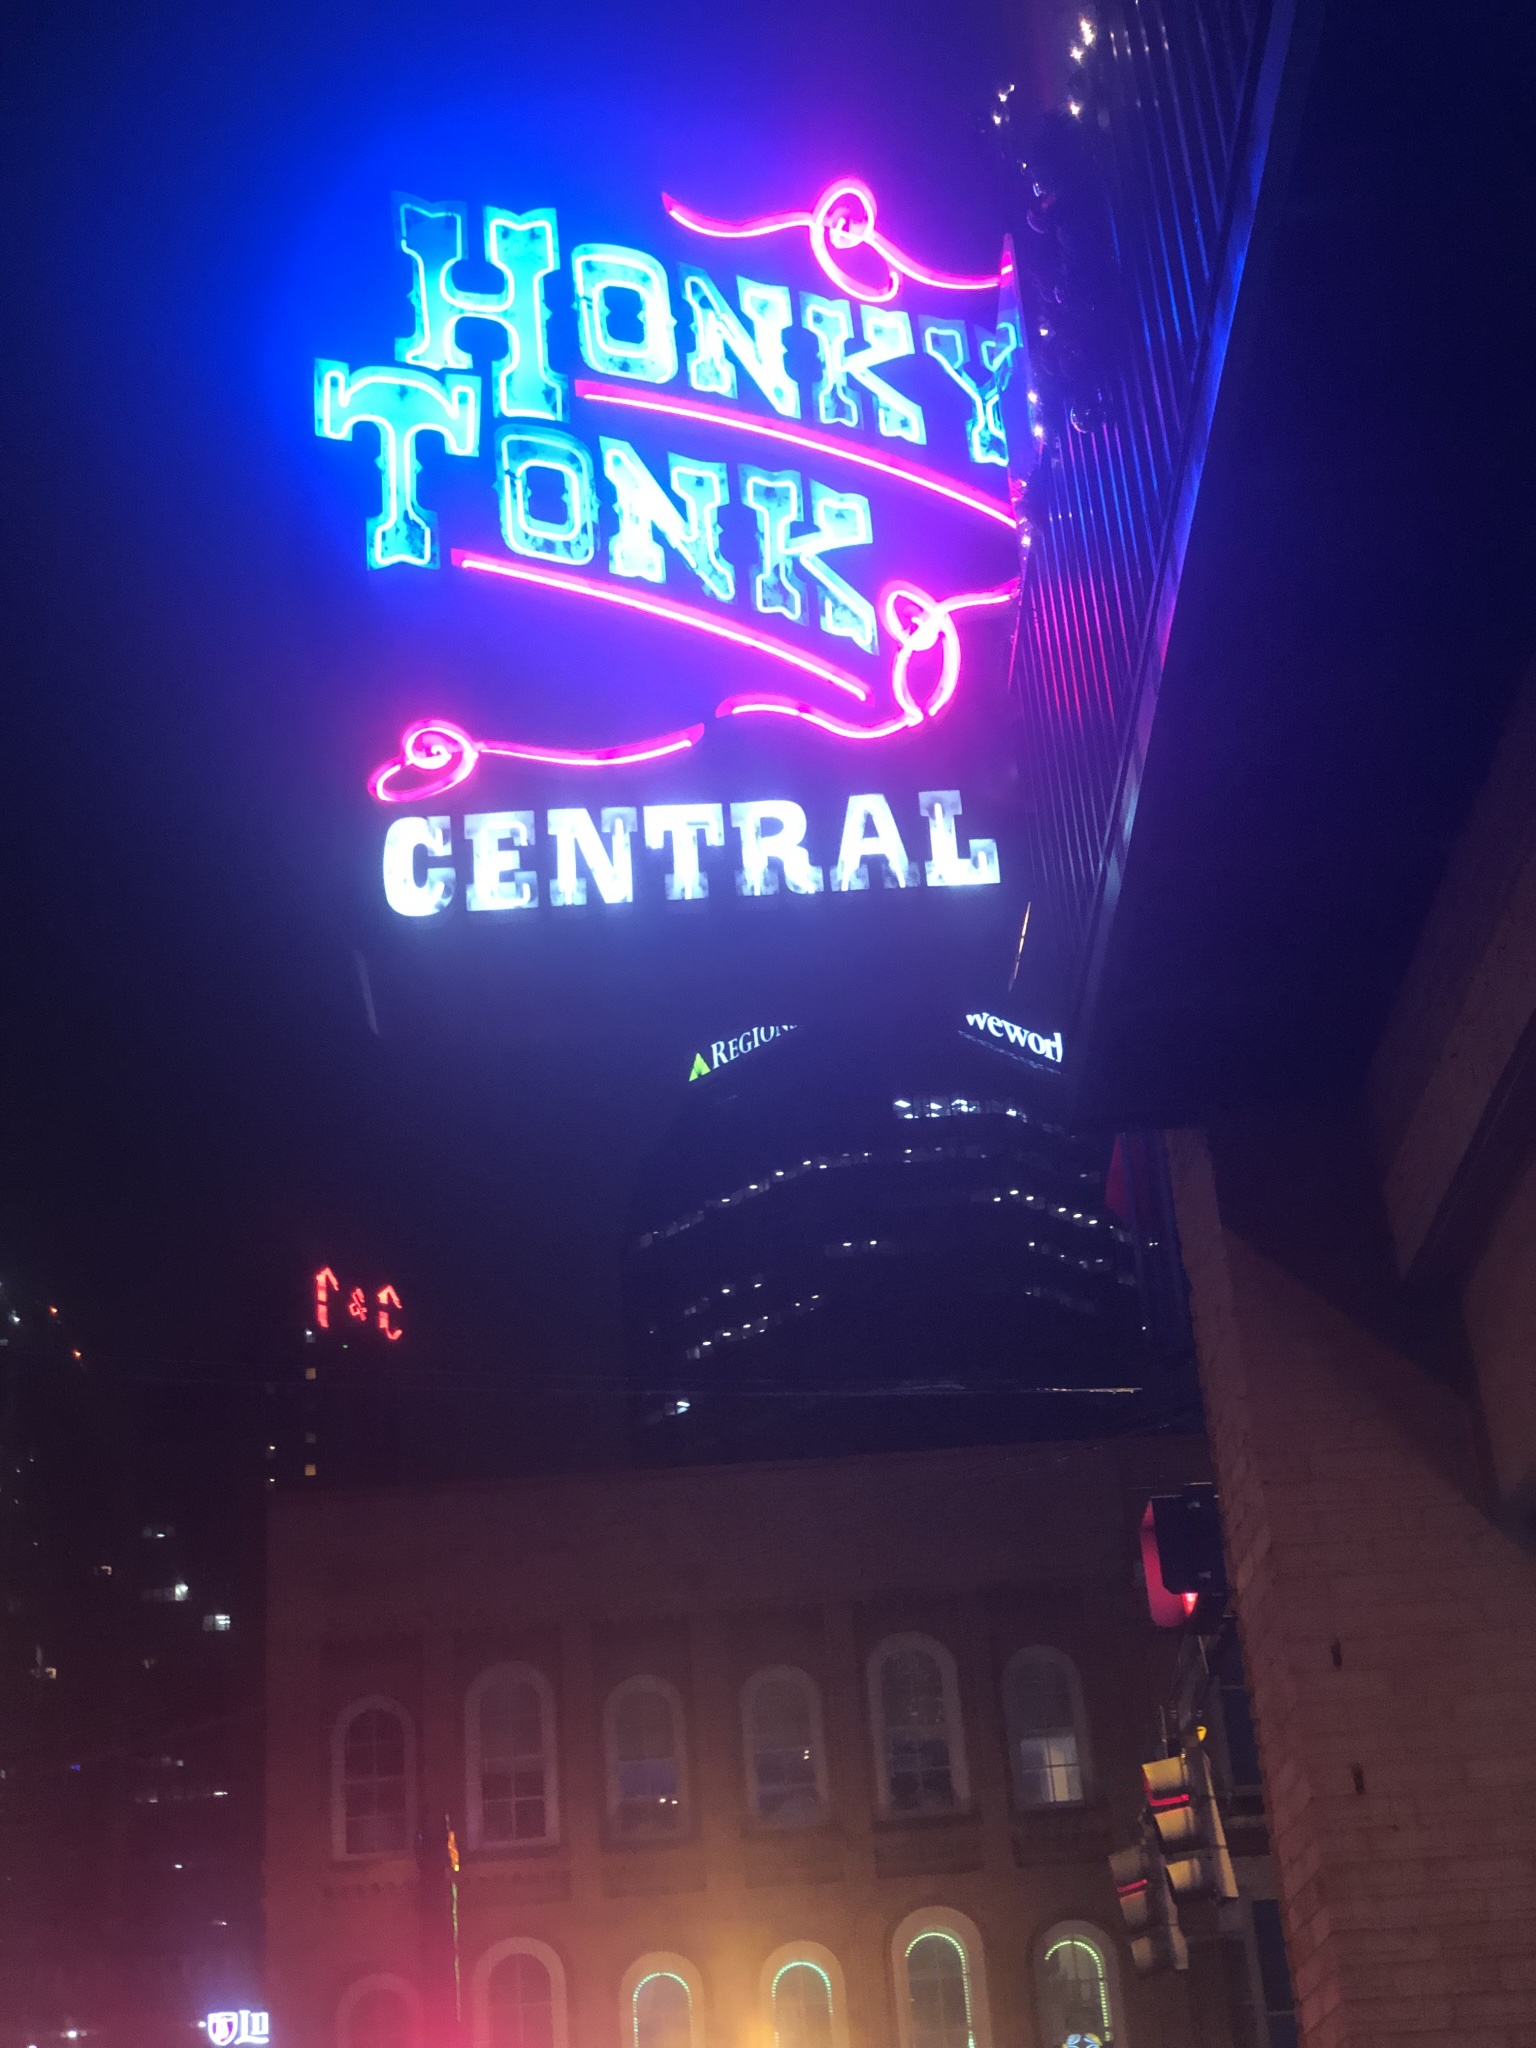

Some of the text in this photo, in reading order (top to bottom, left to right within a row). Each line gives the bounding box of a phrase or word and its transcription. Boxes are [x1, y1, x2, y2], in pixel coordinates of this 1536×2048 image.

[392, 196, 1022, 467] HONKY
[314, 358, 881, 655] TONK
[381, 790, 1000, 918] CENTRAL
[711, 1025, 798, 1069] REGIO
